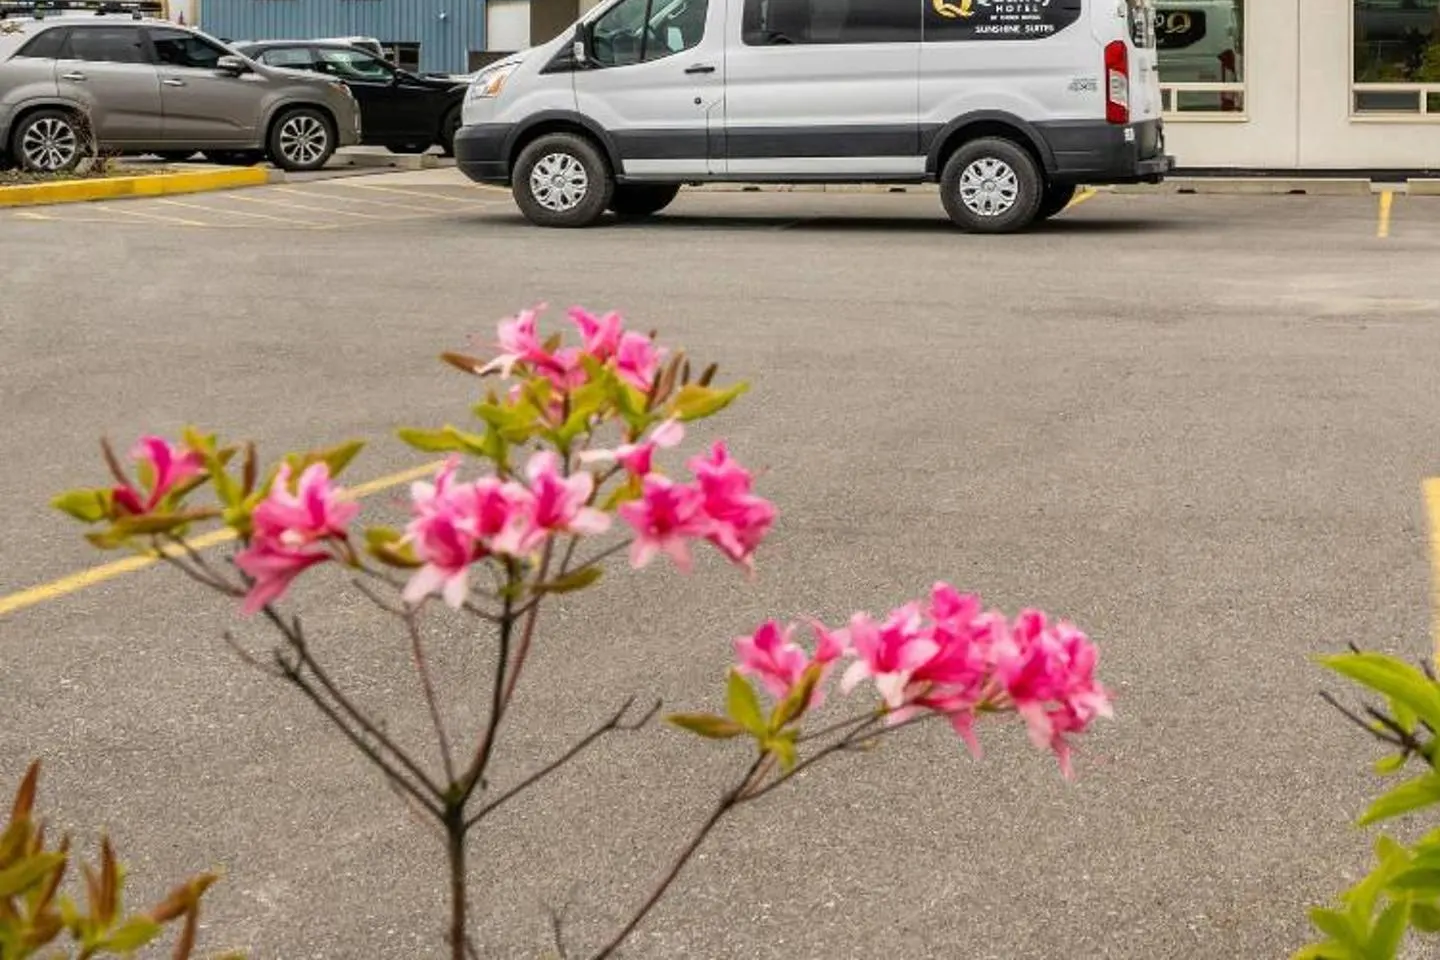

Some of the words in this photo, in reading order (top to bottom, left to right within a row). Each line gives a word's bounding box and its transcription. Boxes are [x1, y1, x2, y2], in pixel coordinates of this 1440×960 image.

[995, 4, 1038, 13] HOTEL
[975, 24, 1021, 34] SUNSHINE
[1025, 24, 1055, 34] SUITES
